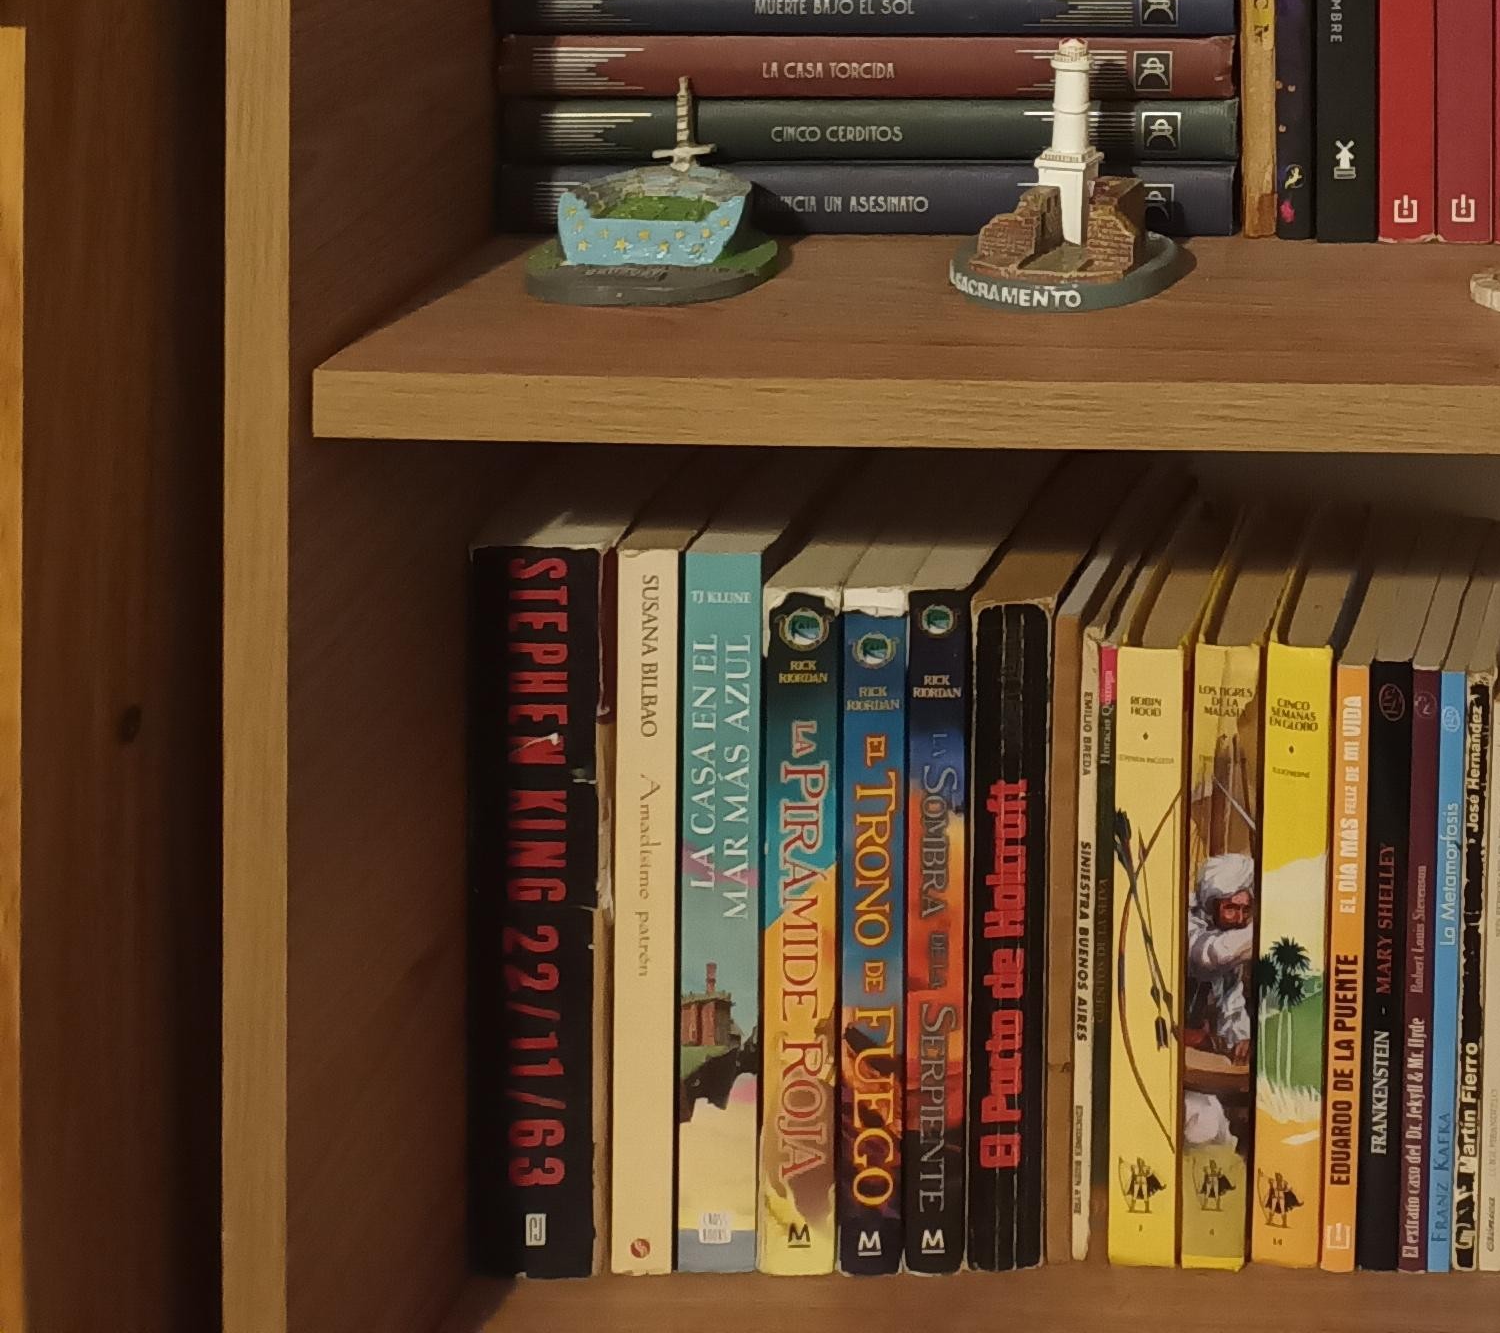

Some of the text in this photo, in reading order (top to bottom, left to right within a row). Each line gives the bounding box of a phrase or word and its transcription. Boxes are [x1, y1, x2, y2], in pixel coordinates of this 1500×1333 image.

[762, 61, 896, 79] LA CASA TORCIDA
[770, 125, 904, 144] CINCO CERDITOS
[824, 195, 930, 215] UN ASESINATO
[640, 573, 659, 739] SUSANA BILBAO
[690, 634, 719, 891] LA CASA EN EL
[504, 556, 569, 1188] STEPHEN KING 22/11/63
[718, 634, 752, 921] MAR MÁS AZUL
[1437, 801, 1461, 946] La Metamorfosis
[778, 719, 829, 1180] LA PIRÁMIDE ROJA
[850, 733, 898, 1208] EL TRONO DE FUEGO
[1074, 840, 1093, 1043] SINIESTRA BUENOS AIRES
[1370, 842, 1396, 1155] FRANKENSTEIN MARY SHELLEY
[1329, 954, 1359, 1187] EDUARDO DE LA PUENTE
